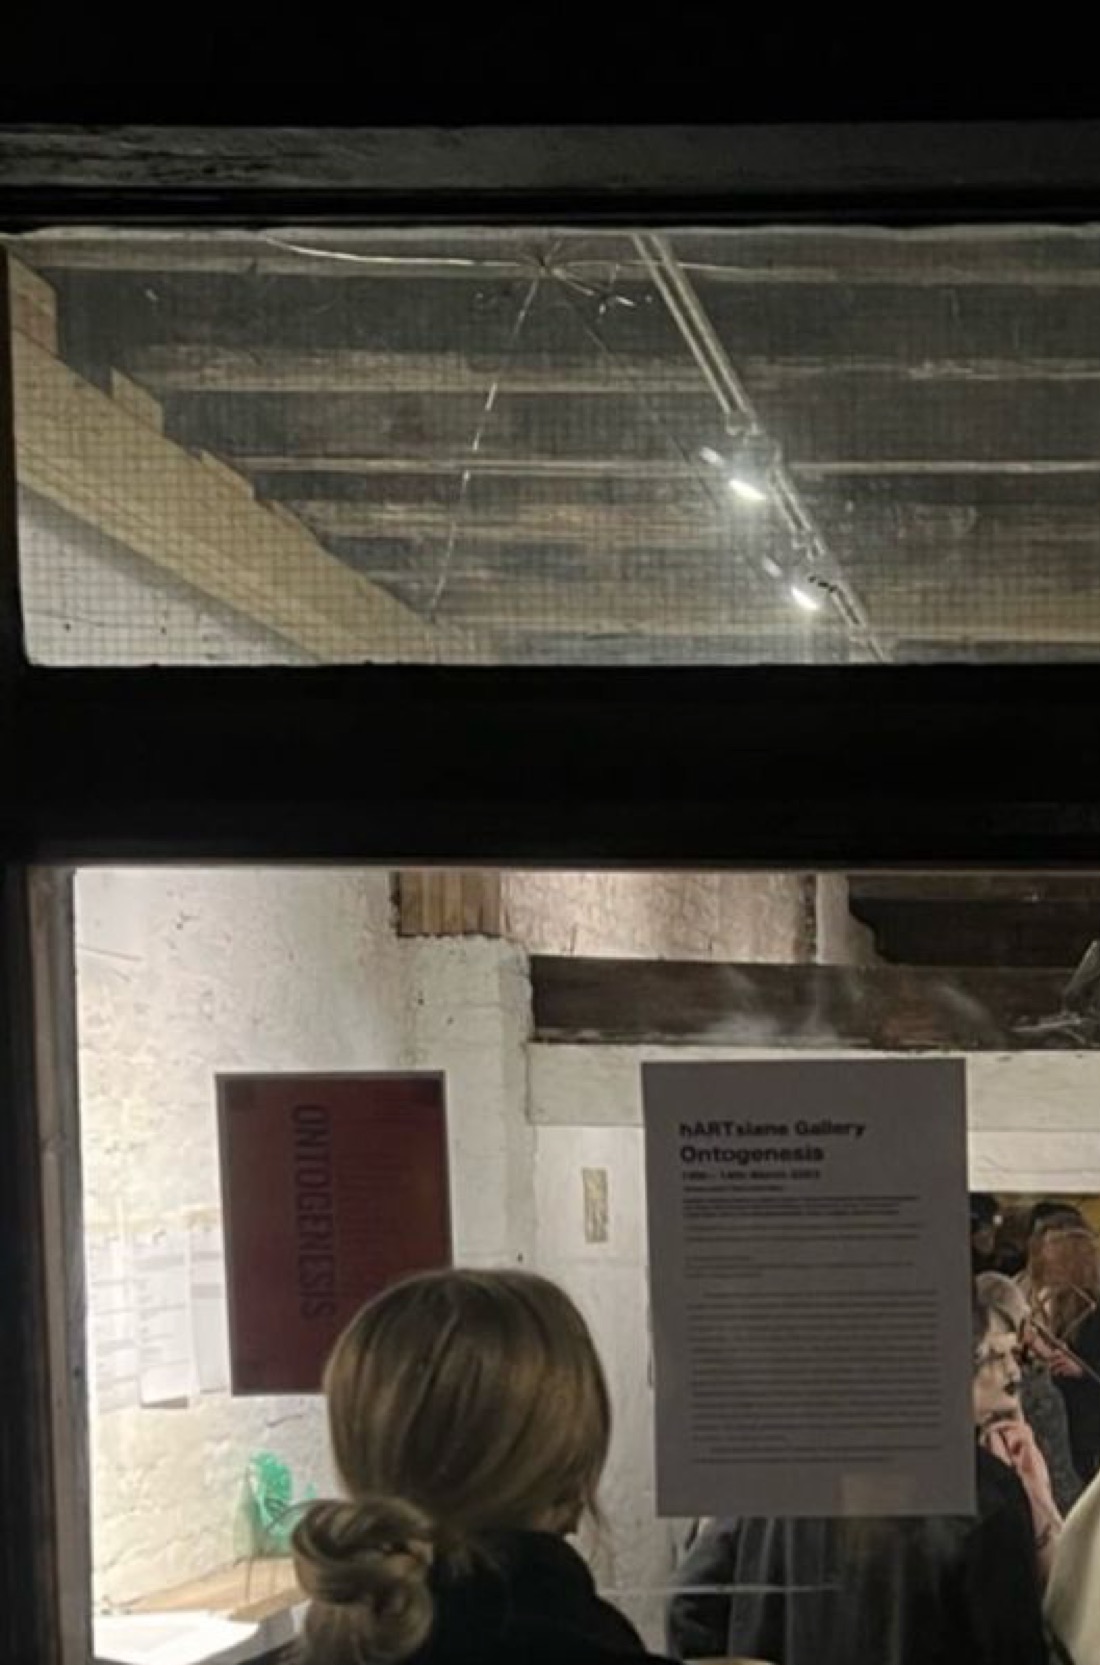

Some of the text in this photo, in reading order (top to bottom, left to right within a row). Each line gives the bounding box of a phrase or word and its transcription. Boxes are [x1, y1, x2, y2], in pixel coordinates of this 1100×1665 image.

[795, 1118, 866, 1139] Gallery
[680, 1144, 825, 1165] Ontogenesis
[293, 1103, 336, 1320] ONTOGENESIS
